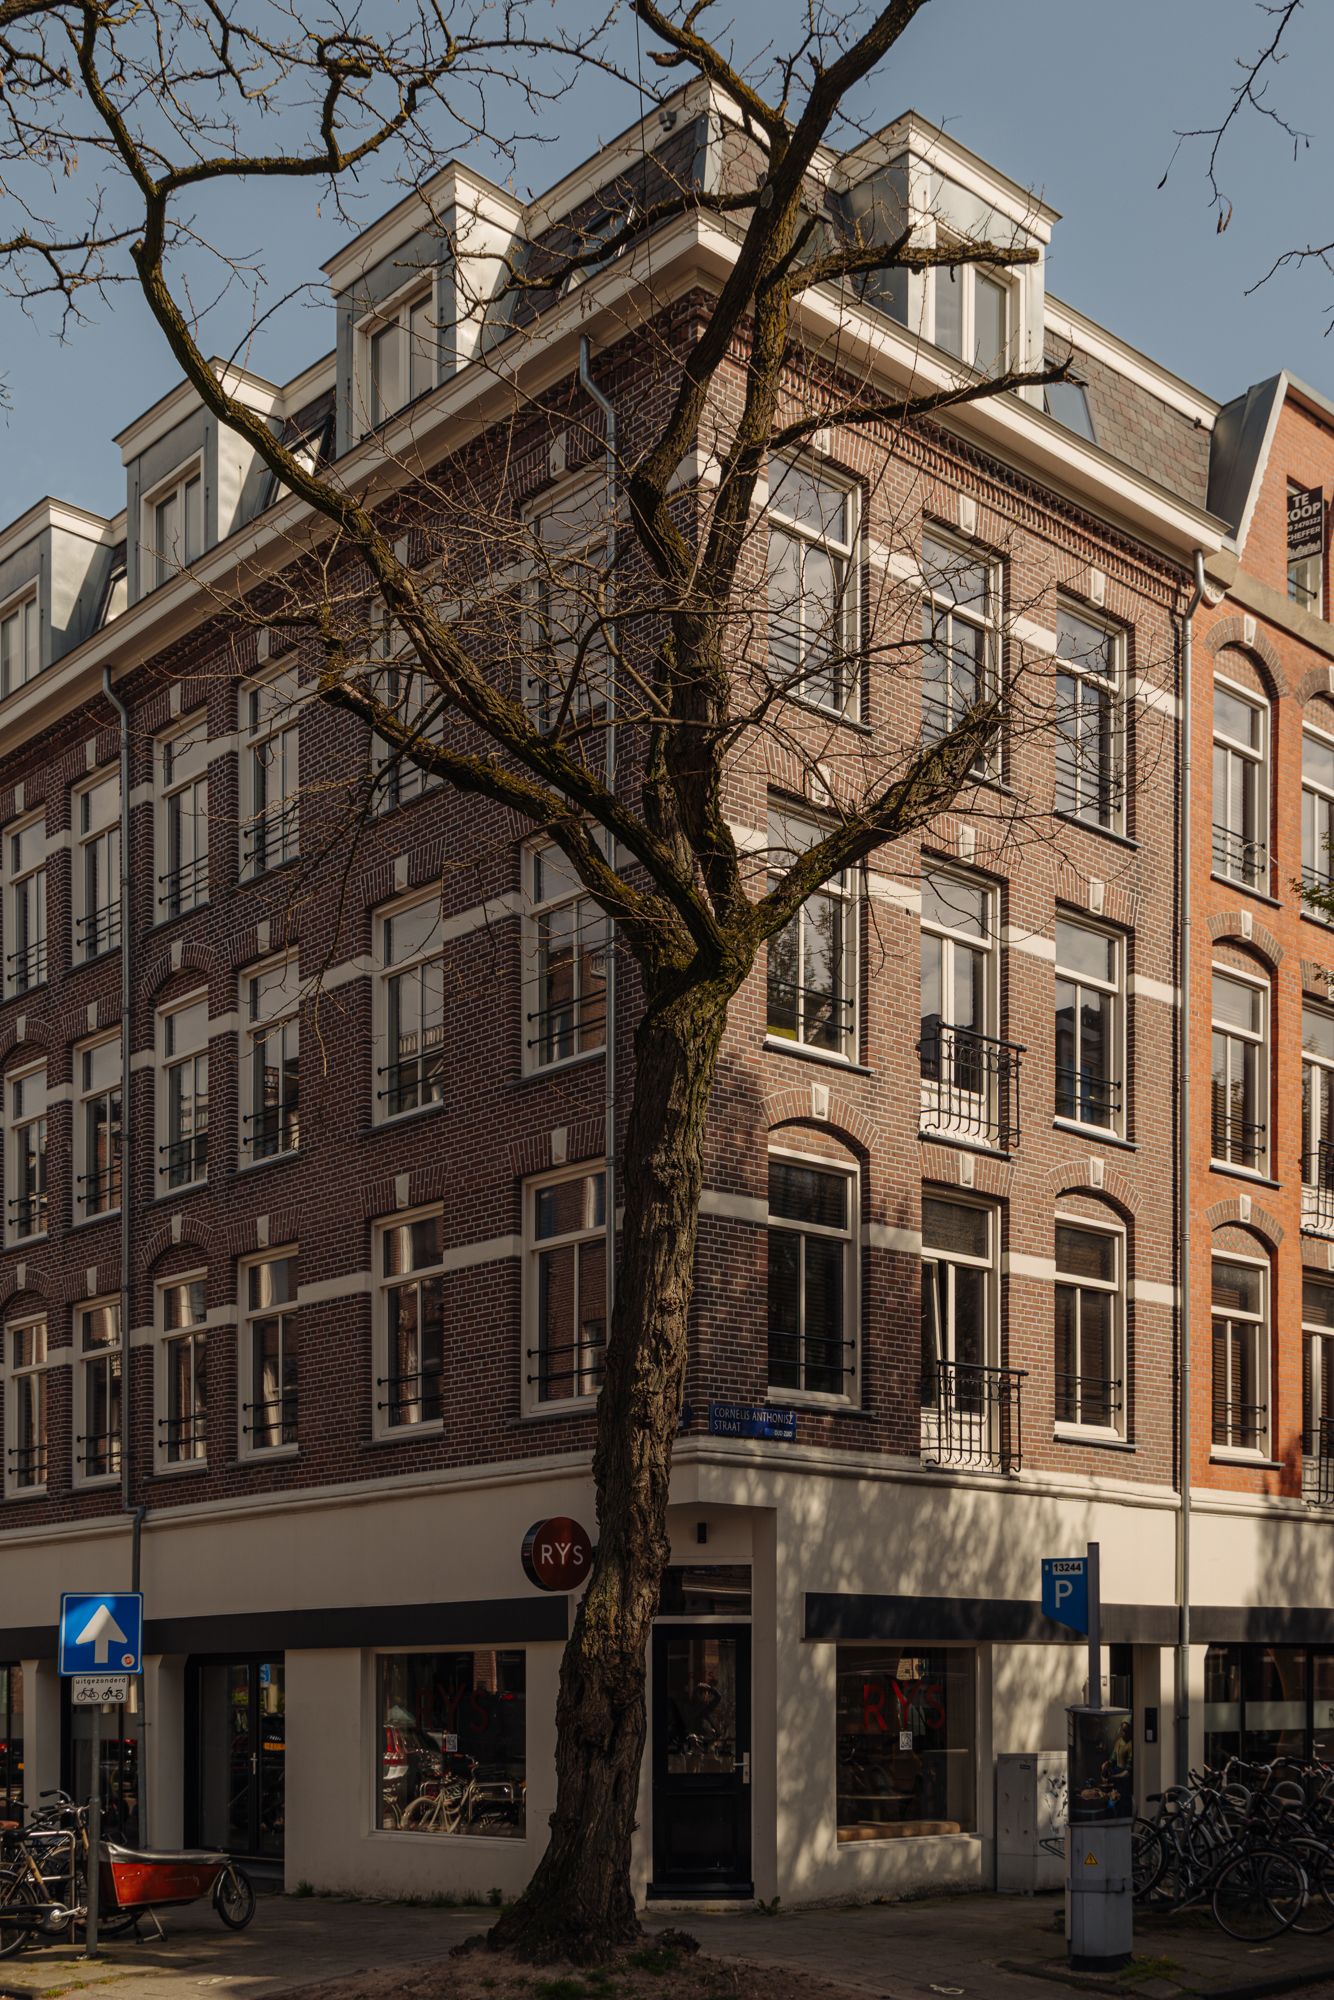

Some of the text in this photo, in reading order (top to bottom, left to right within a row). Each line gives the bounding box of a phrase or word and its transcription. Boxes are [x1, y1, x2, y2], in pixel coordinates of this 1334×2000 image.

[1292, 493, 1310, 508] TE
[714, 1407, 750, 1421] CORNELIS
[714, 1420, 741, 1433] STRAAT
[541, 1542, 584, 1566] RYS
[1053, 1563, 1081, 1572] 13244
[1055, 1580, 1073, 1608] P
[75, 1677, 126, 1685] uitgezonderd
[863, 1678, 945, 1732] RYS
